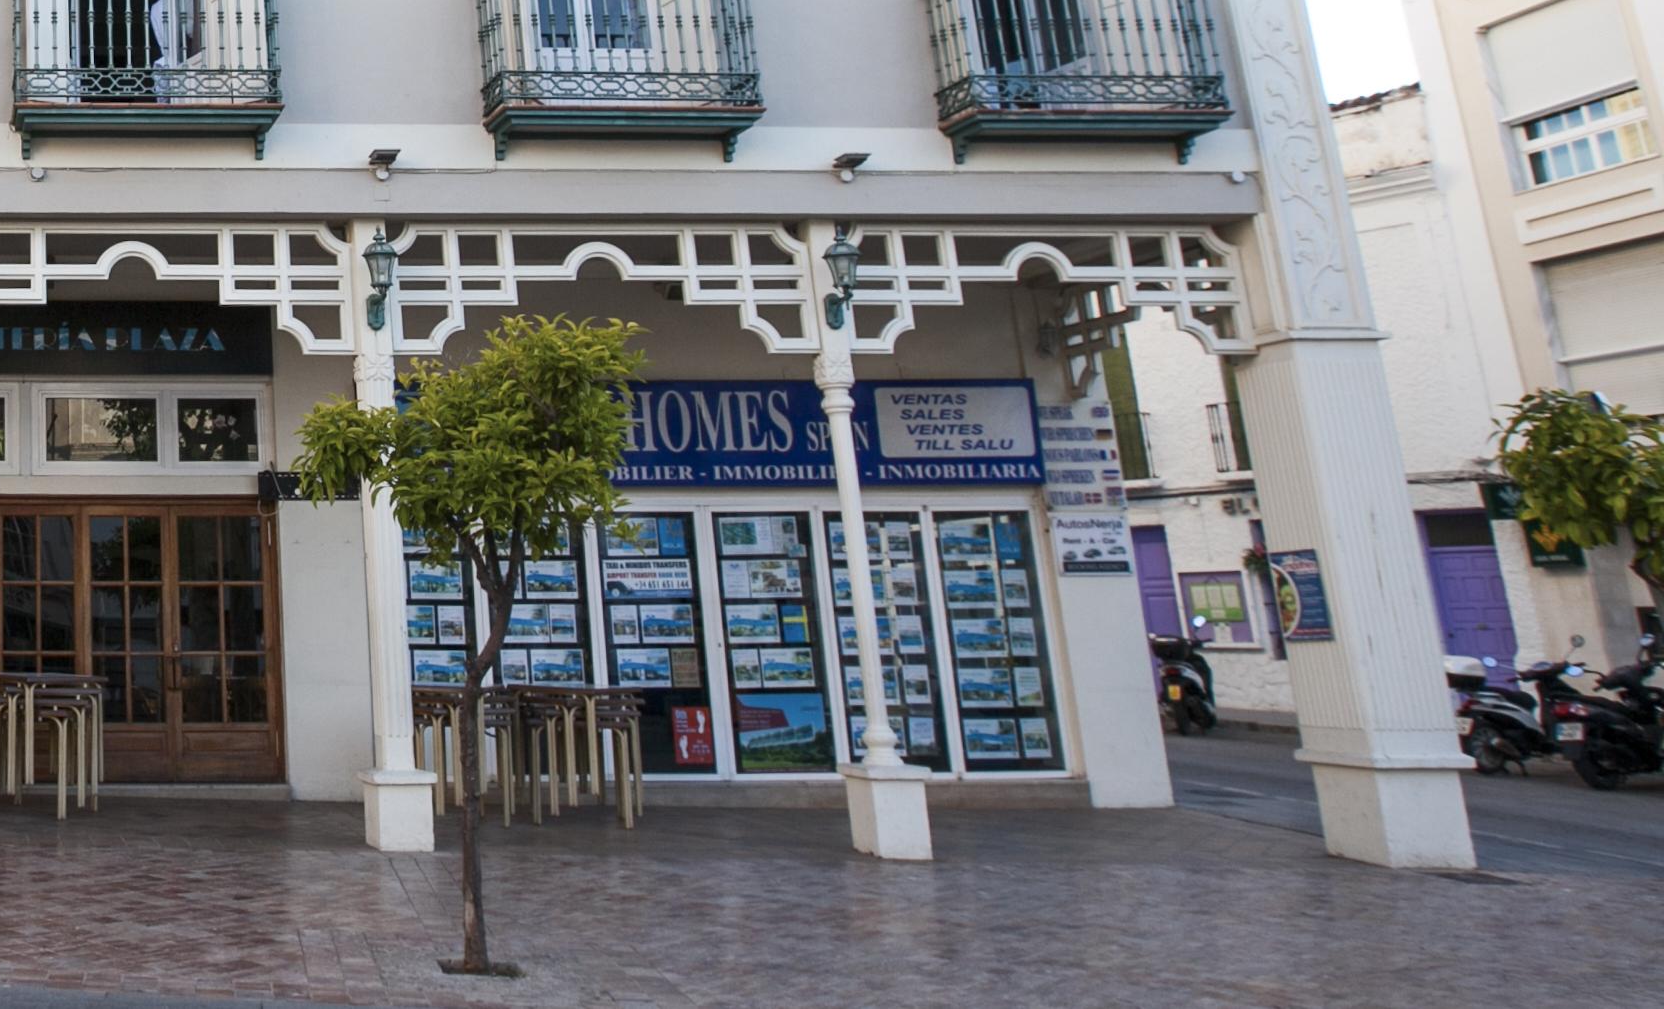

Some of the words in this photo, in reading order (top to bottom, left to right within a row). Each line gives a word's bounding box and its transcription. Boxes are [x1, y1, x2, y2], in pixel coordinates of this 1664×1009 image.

[105, 327, 225, 351] PLAZA
[890, 393, 968, 405] VENTAS
[900, 409, 965, 420] SALES
[619, 390, 793, 453] HOMES
[806, 421, 870, 451] SPN
[906, 424, 984, 435] VENTES
[914, 439, 955, 451] TILL
[960, 439, 1014, 450] SALU
[878, 463, 1041, 479] INMOBILIARIA
[1056, 519, 1123, 531] AutosNerja
